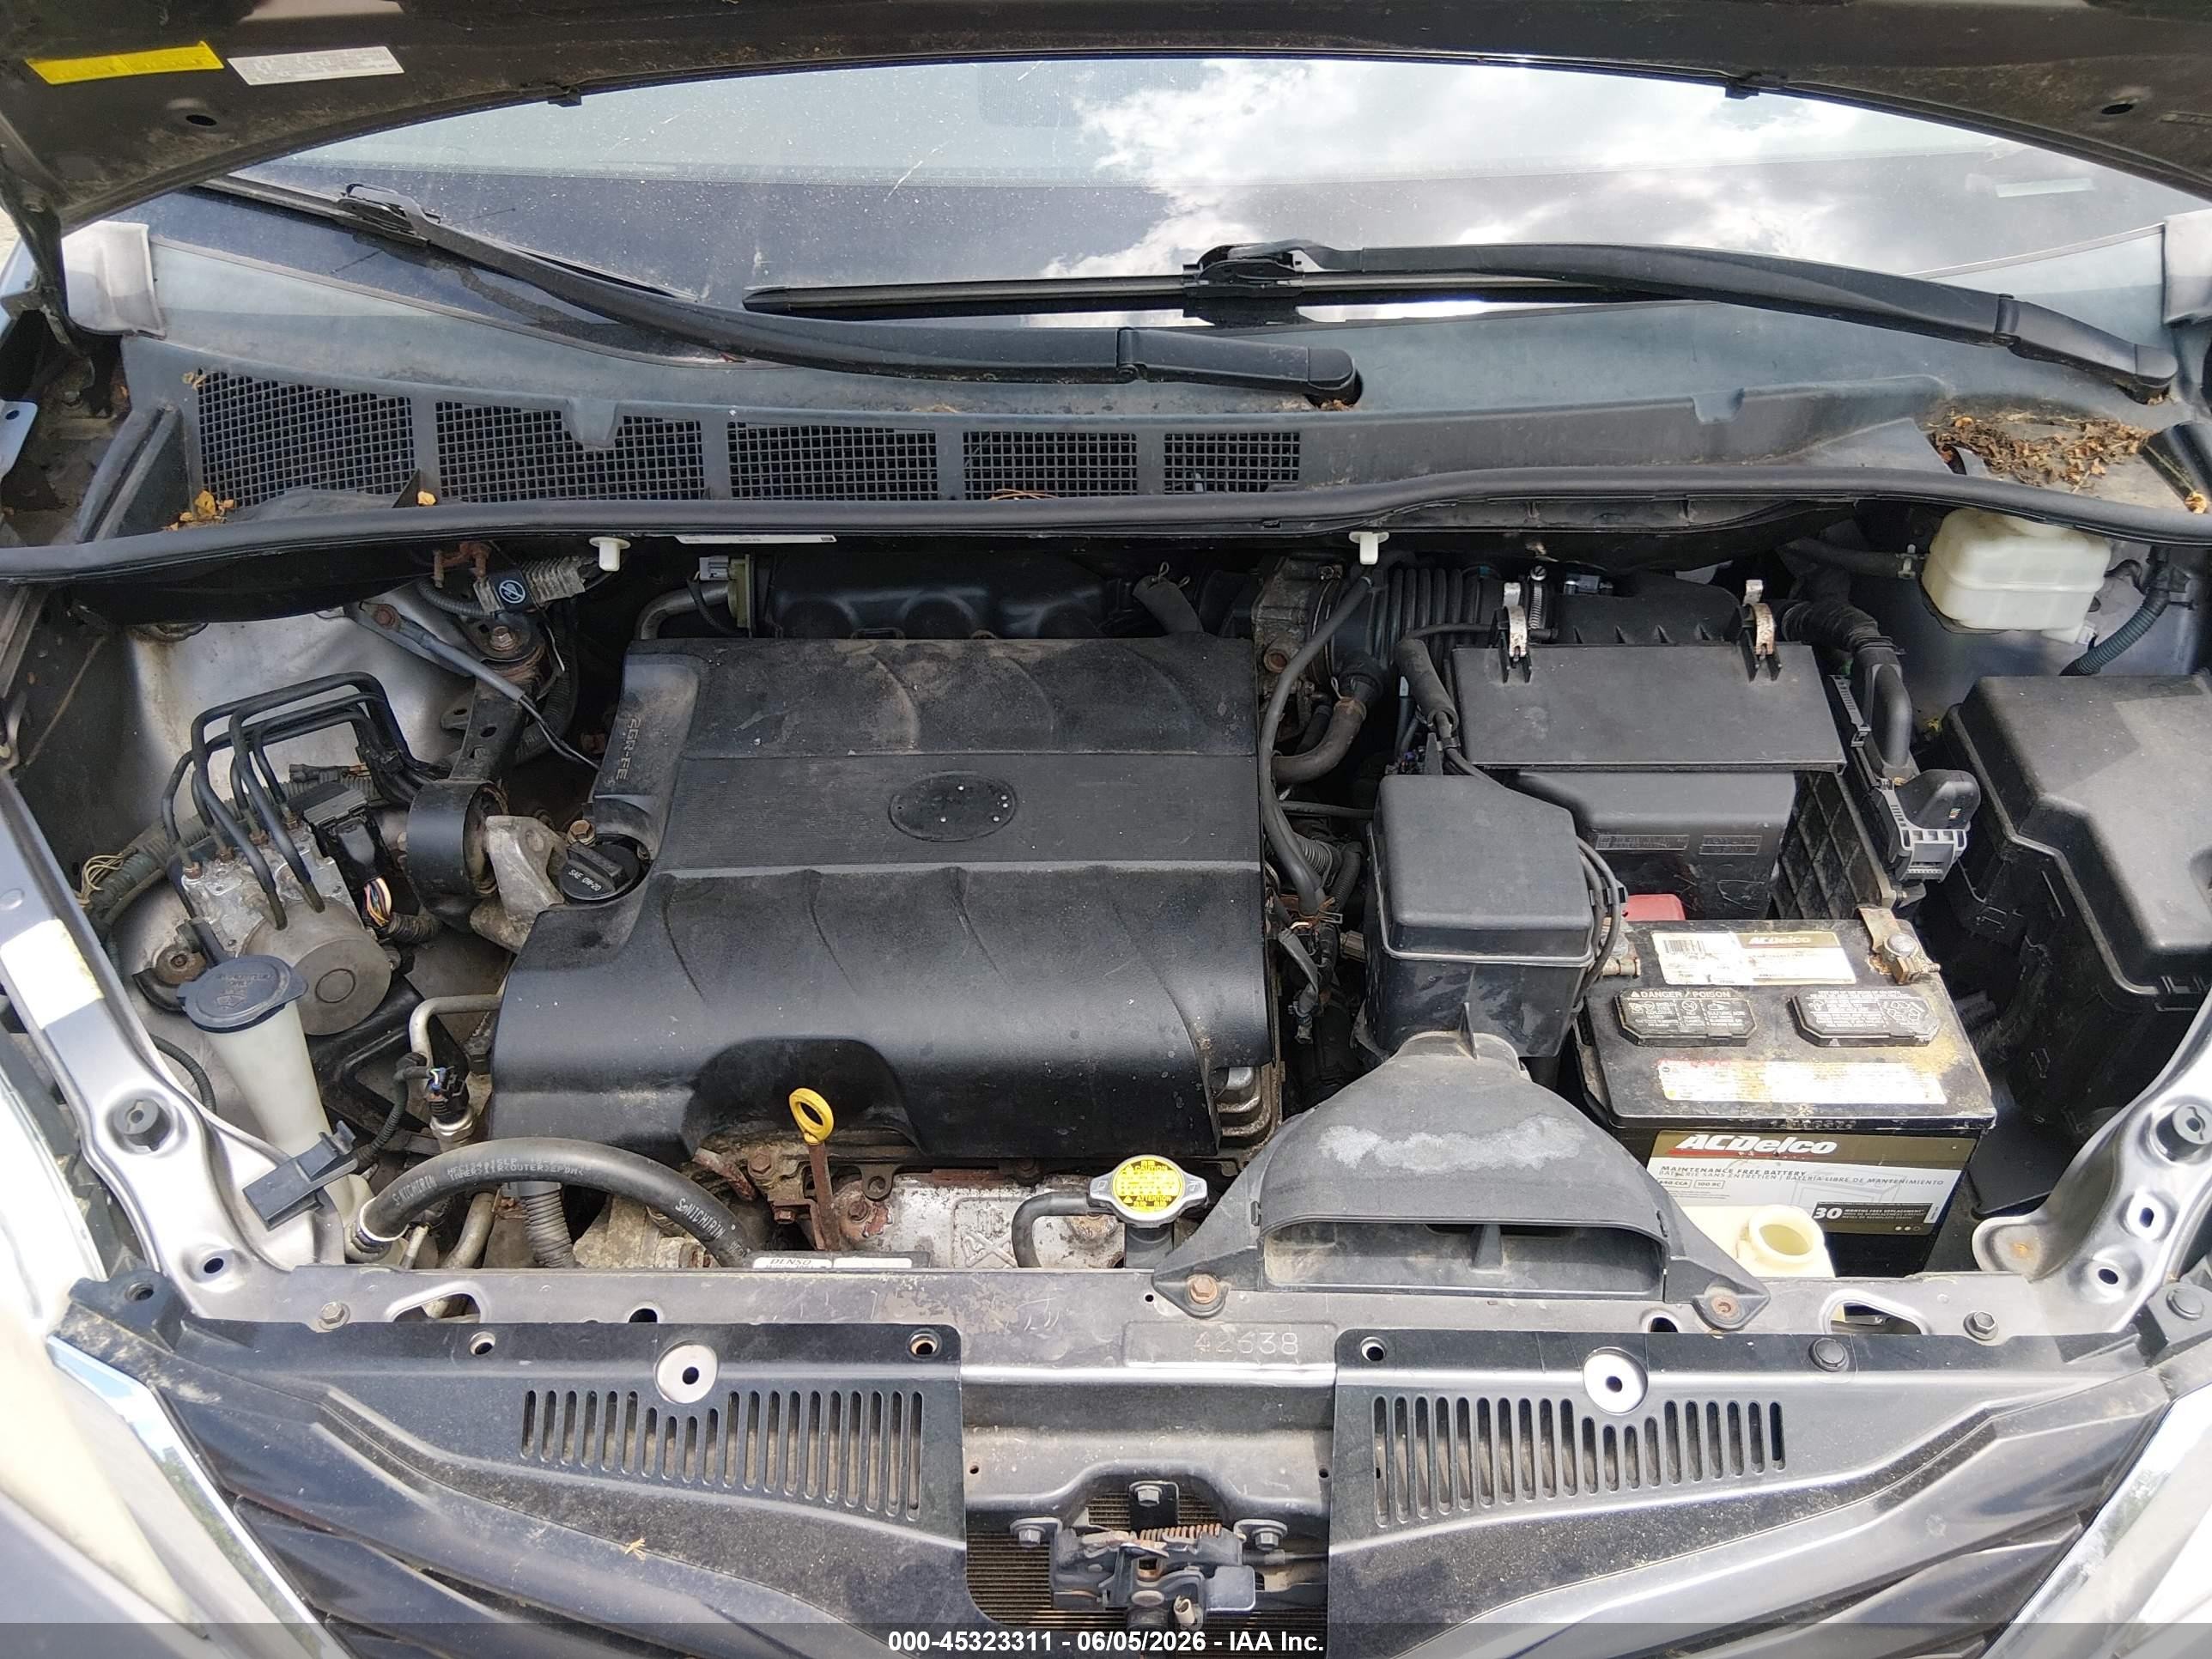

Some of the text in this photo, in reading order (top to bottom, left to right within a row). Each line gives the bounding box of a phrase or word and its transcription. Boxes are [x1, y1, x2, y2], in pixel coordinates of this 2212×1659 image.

[616, 718, 641, 780] 2GR-FE
[568, 869, 584, 879] SAE
[1675, 1133, 1838, 1153] ACDelco
[1813, 1207, 1843, 1219] 30
